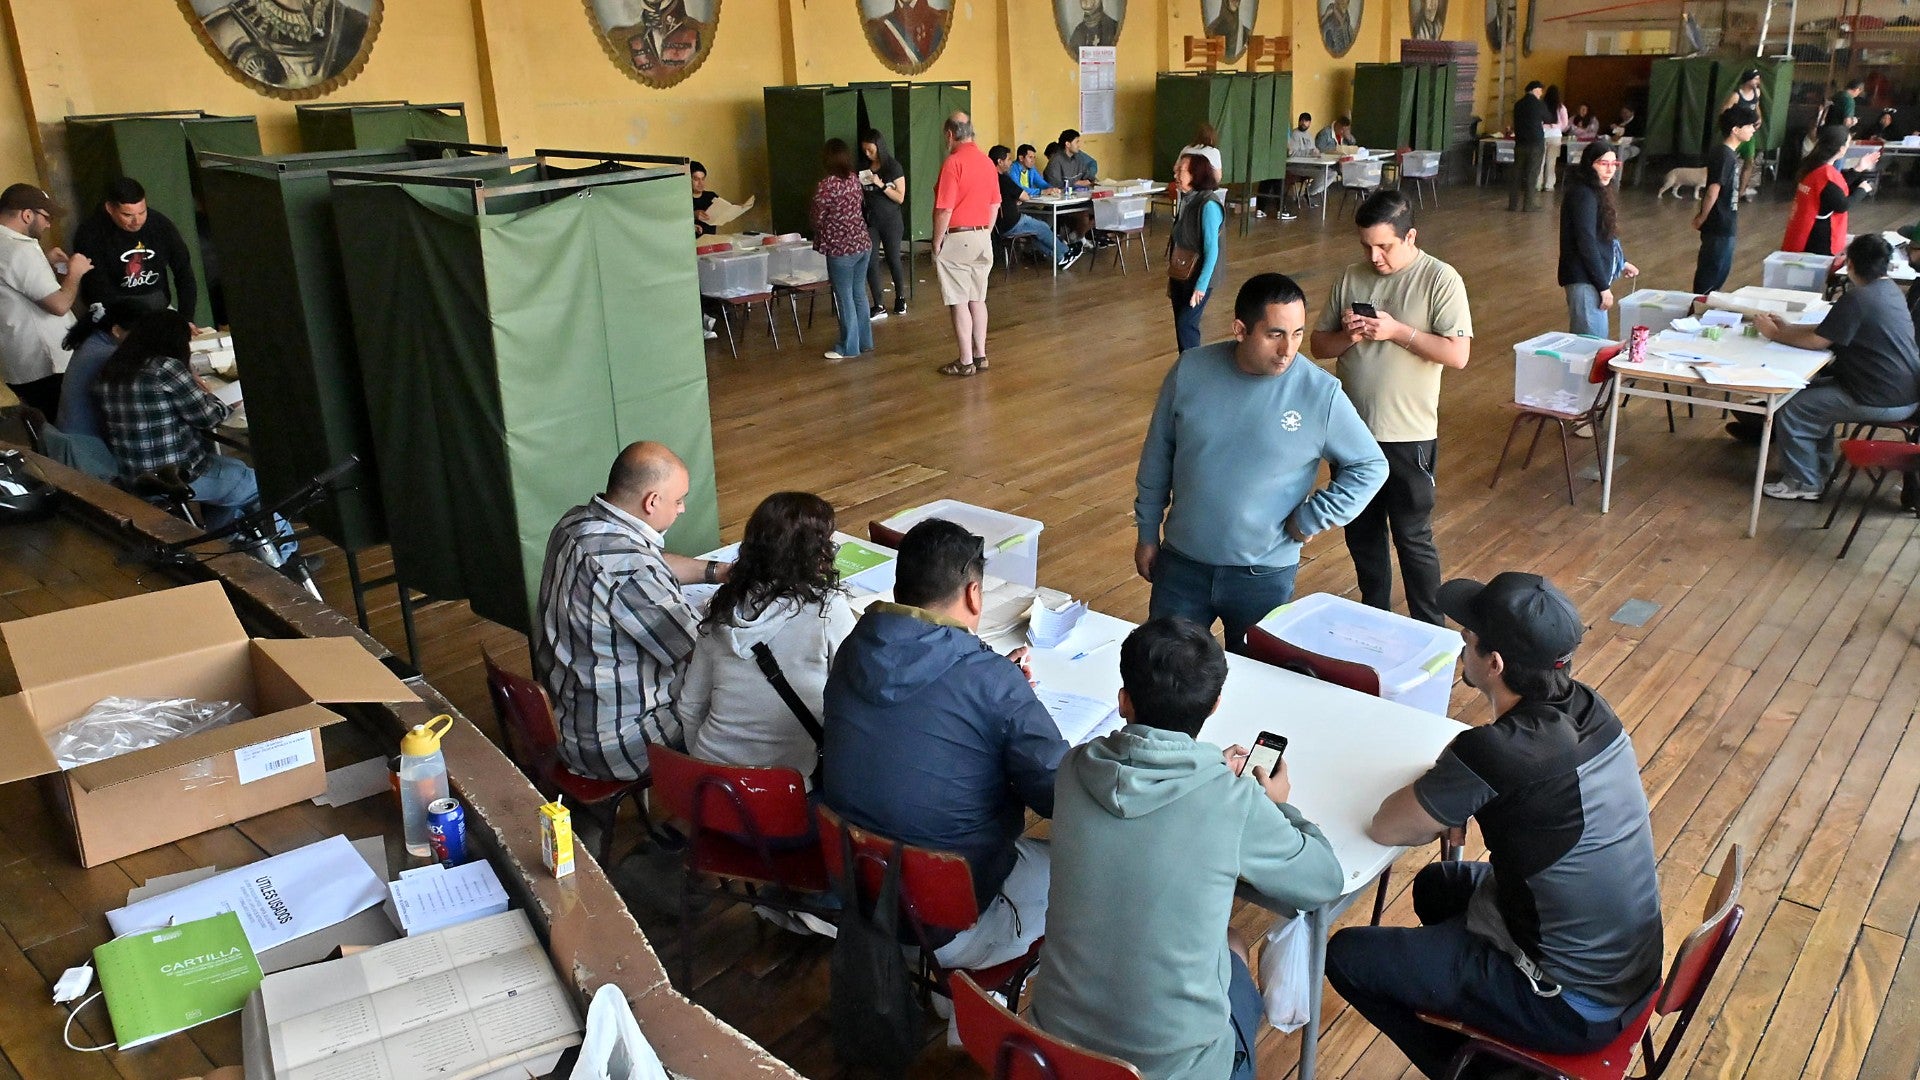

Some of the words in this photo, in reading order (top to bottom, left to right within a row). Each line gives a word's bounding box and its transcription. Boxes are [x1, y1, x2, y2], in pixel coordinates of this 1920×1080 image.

[255, 875, 278, 900] ÚTILES
[267, 897, 293, 925] USADOS
[160, 946, 241, 974] CARTILLA
